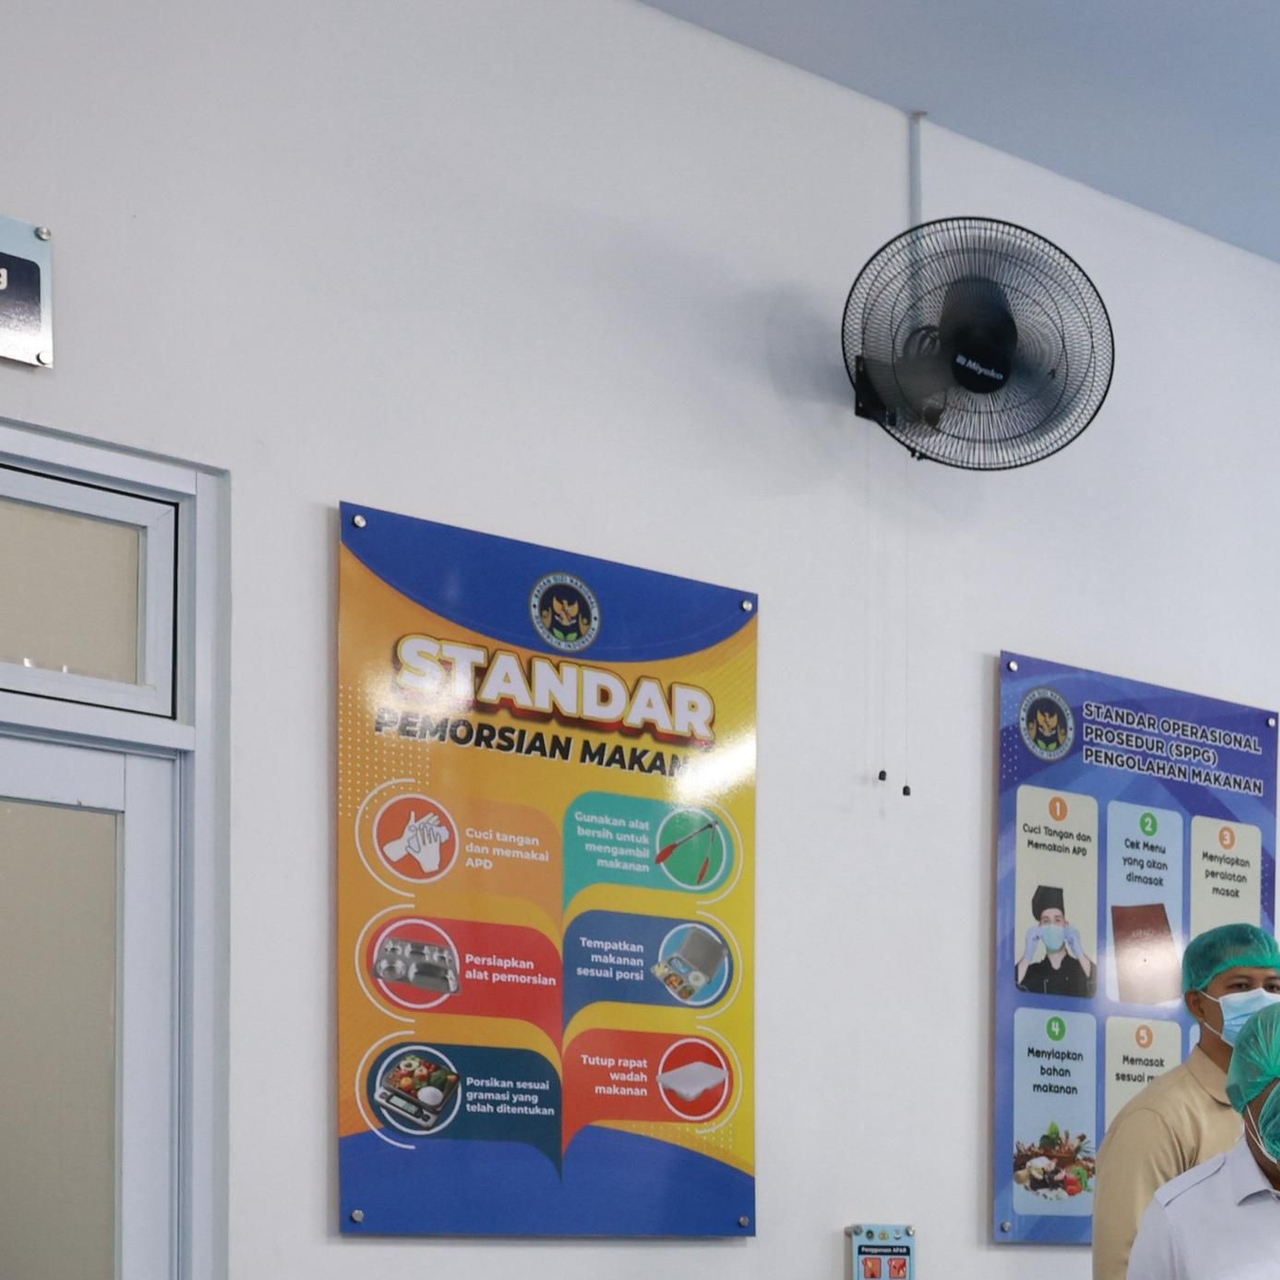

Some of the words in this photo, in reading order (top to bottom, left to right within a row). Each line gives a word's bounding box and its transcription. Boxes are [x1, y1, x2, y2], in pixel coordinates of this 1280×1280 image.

[396, 635, 715, 746] STANDAR
[1083, 702, 1157, 731] STANDAR
[1160, 719, 1262, 754] OPERASIONAL
[375, 708, 572, 761] PEMORSIAN
[579, 739, 690, 778] MAKAN
[1083, 724, 1166, 755] PROSEDUR
[1168, 744, 1218, 768] (SPPG)
[1083, 748, 1188, 783] PENGOLAHAN
[1191, 768, 1263, 796] MAKANAN
[1055, 802, 1061, 816] 1
[575, 811, 626, 829] Gunakan
[629, 816, 650, 831] alat
[1144, 818, 1153, 831] 2
[466, 827, 492, 842] Cuci
[496, 830, 539, 847] tangan
[577, 826, 613, 841] bersih
[616, 830, 649, 844] untuk
[1023, 823, 1041, 836] Cuci
[1043, 826, 1074, 841] Tangan
[1076, 831, 1092, 843] dan
[1222, 832, 1231, 845] 3
[466, 842, 489, 854] dan
[493, 845, 549, 862] memakai
[585, 842, 650, 860] mengambil
[1072, 846, 1087, 857] APD
[1125, 839, 1140, 850] Cek
[1142, 841, 1166, 854] Menu
[466, 857, 492, 870] APD
[597, 857, 650, 873] makanan
[1122, 856, 1144, 870] yang
[1146, 858, 1168, 871] akan
[1202, 851, 1250, 869] Menyiapkan
[1126, 872, 1163, 887] dimasak
[1205, 869, 1247, 884] peralatan
[1212, 886, 1240, 898] masak
[580, 937, 644, 954] Tempatkan
[465, 954, 534, 971] Persiapkan
[591, 952, 644, 967] makanan
[465, 968, 489, 981] alat
[493, 971, 556, 989] pemorsian
[576, 966, 613, 979] sesuai
[617, 968, 644, 983] porsi
[1052, 1021, 1060, 1035] 4
[1140, 1030, 1148, 1043] 5
[581, 1054, 615, 1069] Tutup
[617, 1057, 648, 1071] rapat
[1027, 1048, 1084, 1063] Menyiapkan
[1122, 1055, 1165, 1068] Memasak
[609, 1070, 648, 1082] wadah
[1040, 1065, 1070, 1078] bahan
[1115, 1072, 1145, 1083] sesuai
[466, 1077, 513, 1090] Porsikan
[516, 1079, 549, 1090] sesuai
[595, 1084, 648, 1097] makanan
[1033, 1083, 1078, 1095] makanan
[466, 1090, 509, 1104] gramasi
[512, 1092, 538, 1105] yang
[466, 1103, 493, 1114] telah
[497, 1104, 554, 1116] ditentukan
